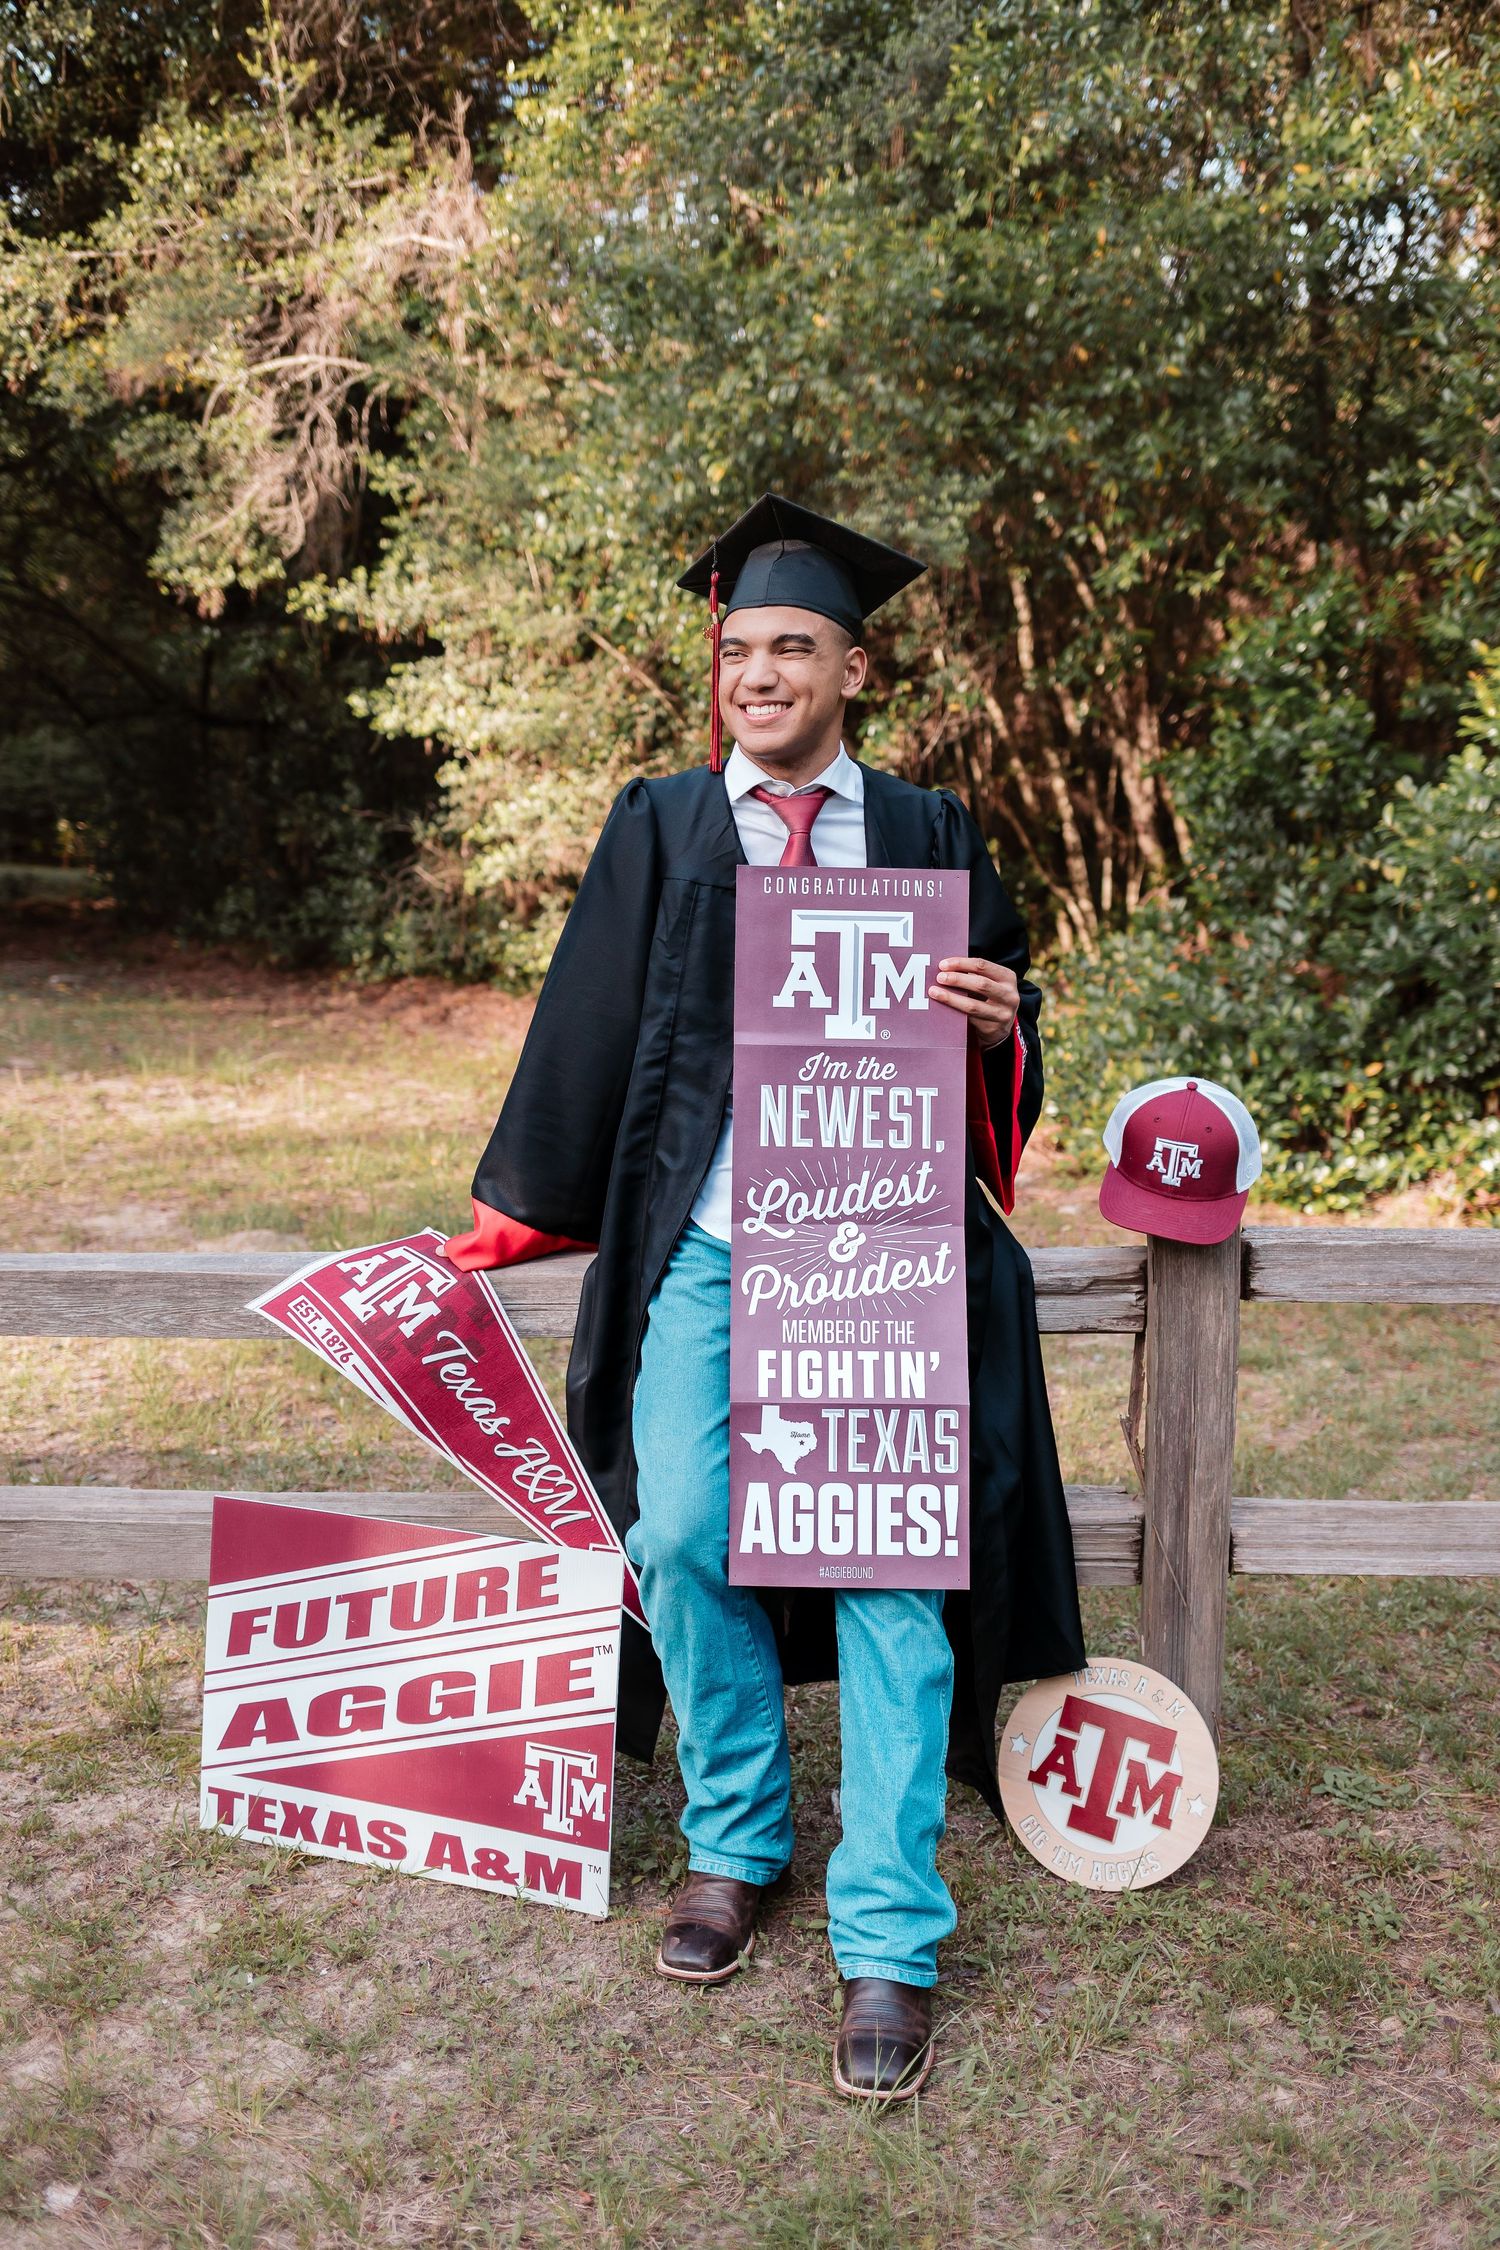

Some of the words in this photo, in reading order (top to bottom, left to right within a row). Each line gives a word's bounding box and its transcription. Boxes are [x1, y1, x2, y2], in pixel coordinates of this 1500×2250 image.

[763, 877, 943, 898] CONGRATULATIONS!
[798, 1052, 851, 1082] I'm
[855, 1057, 898, 1080] the
[759, 1084, 945, 1153] NEWEST,
[742, 1160, 937, 1239] Loudest
[828, 1221, 867, 1263] &
[741, 1242, 957, 1316] Proudest
[292, 1299, 322, 1330] EST.
[320, 1327, 355, 1364] 1876
[782, 1320, 855, 1344] MEMBER
[860, 1321, 881, 1344] OF
[884, 1320, 915, 1345] THE
[758, 1350, 941, 1399] FIGHTIN'
[421, 1330, 511, 1439] Texas
[493, 1437, 592, 1530] A&M
[821, 1408, 960, 1474] TEXAS
[739, 1482, 960, 1557] AGGIES!
[226, 1553, 560, 1658] FUTURE
[819, 1566, 874, 1579] #AGGIEBOUND
[217, 1647, 595, 1751] AGGIE
[1071, 1666, 1131, 1688] TEXAS
[1133, 1675, 1149, 1695] A
[1151, 1689, 1165, 1706] &
[1166, 1698, 1187, 1720] M
[207, 1786, 408, 1861] TEXAS
[424, 1831, 583, 1900] A&M
[1019, 1814, 1050, 1850] GIG
[1090, 1851, 1162, 1882] AGGIES
